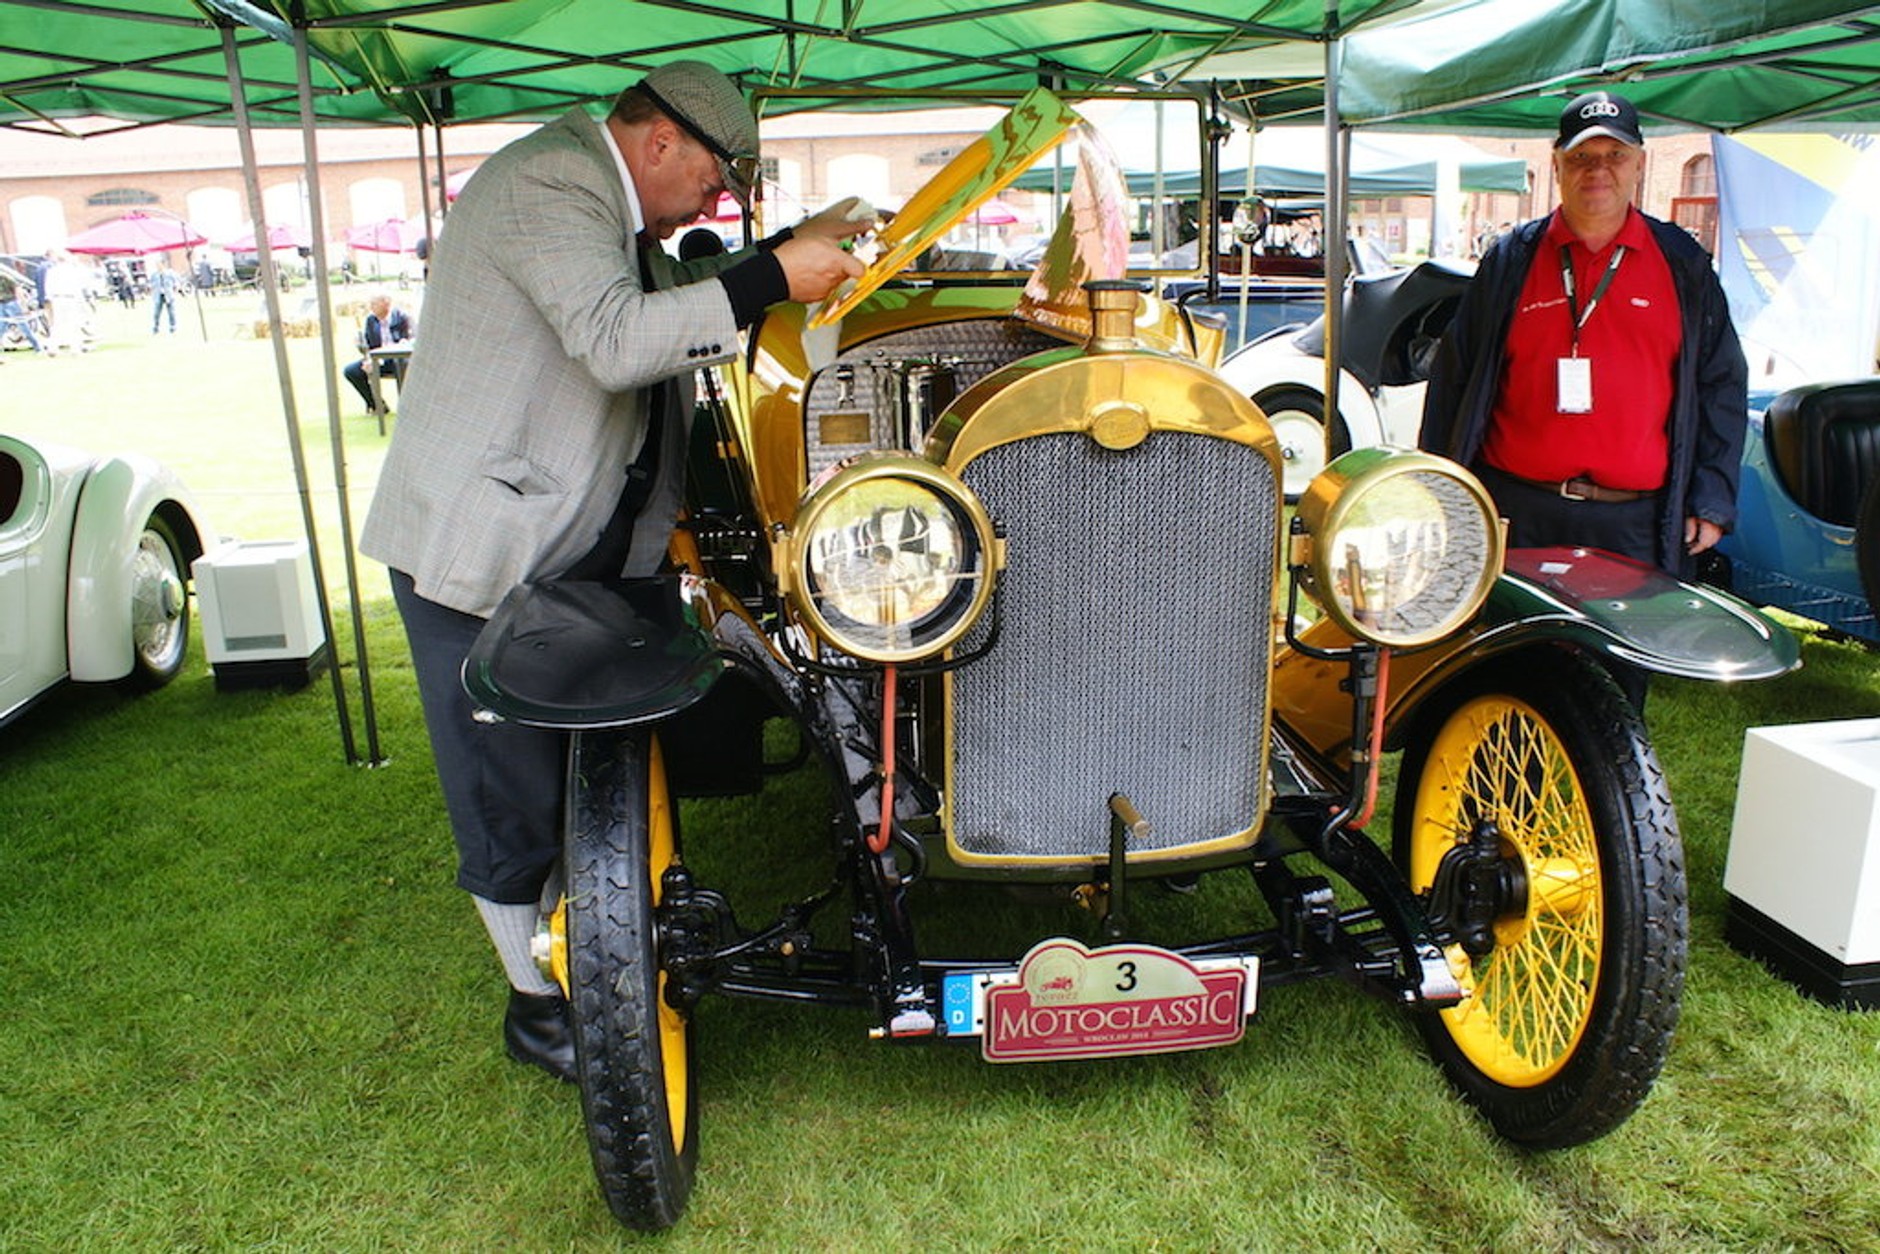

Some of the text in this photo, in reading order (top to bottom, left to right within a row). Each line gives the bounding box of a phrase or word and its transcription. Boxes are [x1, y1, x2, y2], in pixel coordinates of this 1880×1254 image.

[1115, 961, 1138, 992] 3
[952, 1010, 965, 1024] D
[998, 990, 1235, 1041] MOTOCLASSIC
